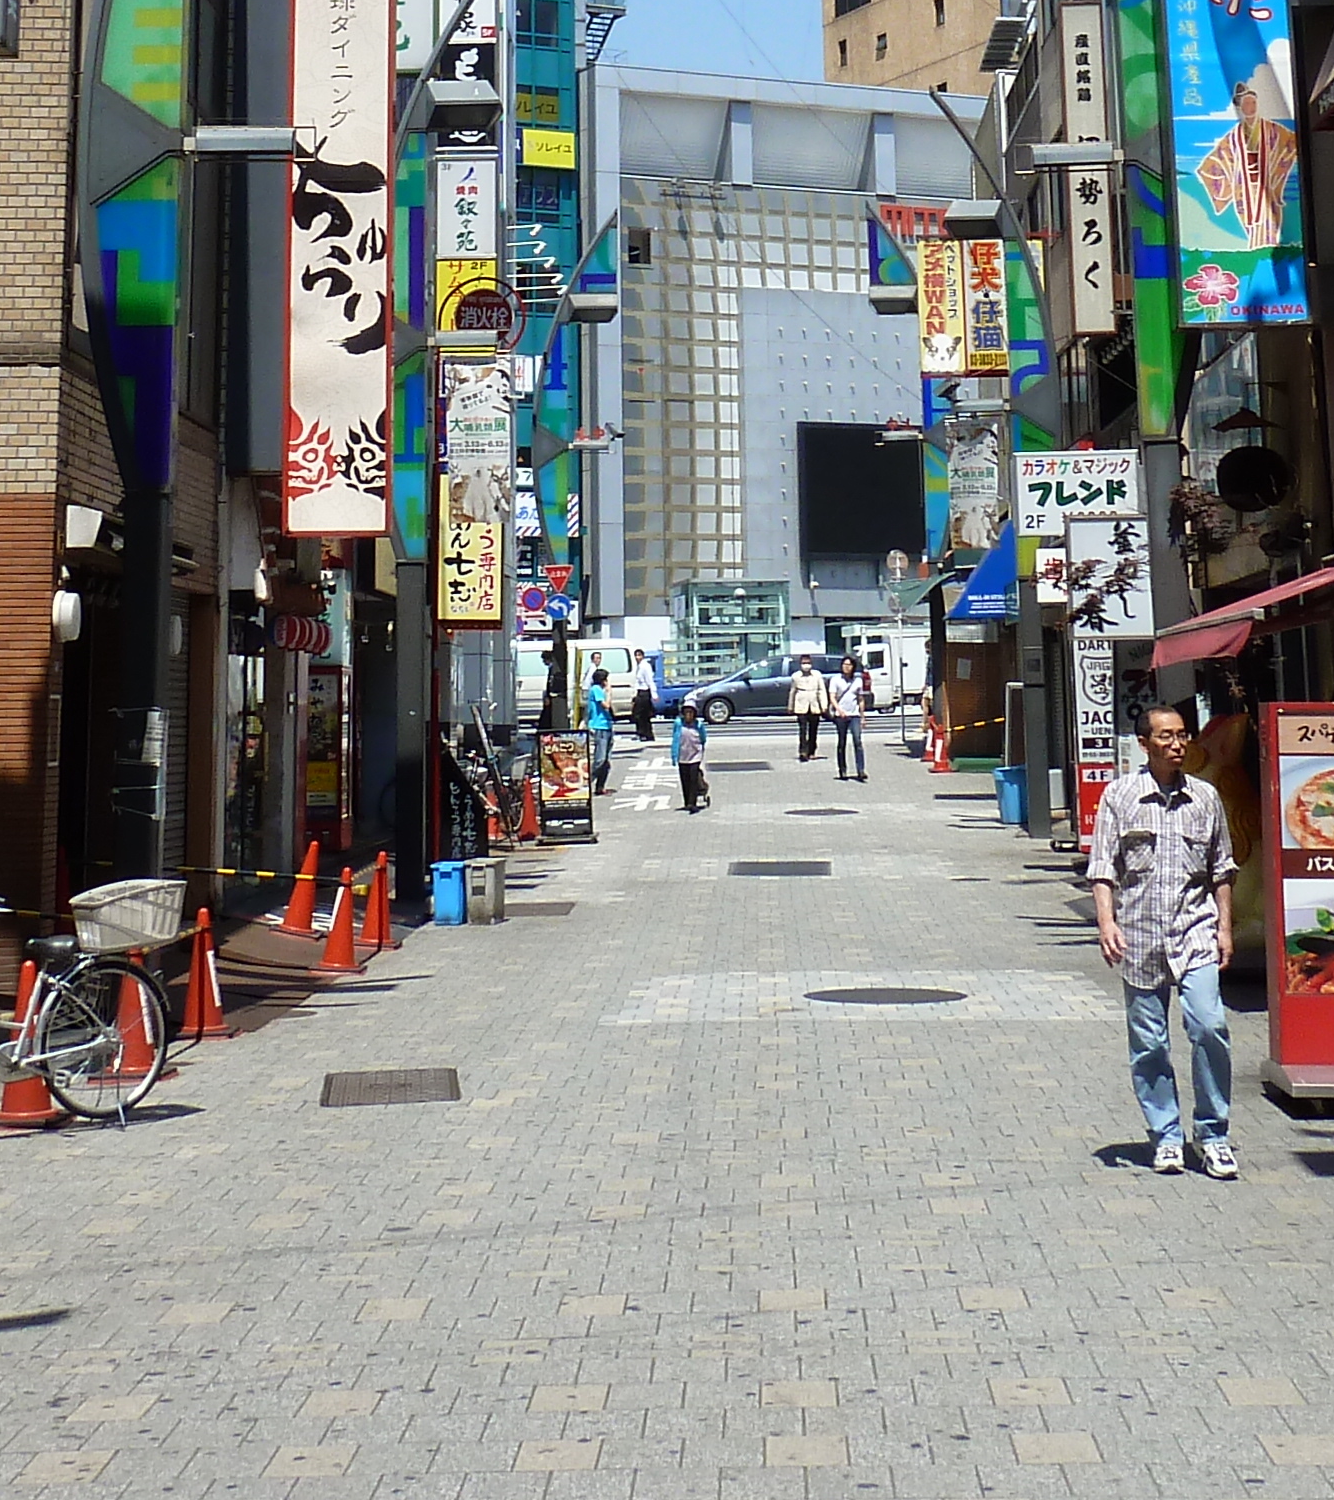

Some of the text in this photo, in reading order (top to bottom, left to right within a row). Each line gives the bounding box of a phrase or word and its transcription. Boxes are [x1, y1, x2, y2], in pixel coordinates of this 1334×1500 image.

[1077, 136, 1104, 289] 勢ろく
[470, 262, 488, 270] 2F
[460, 307, 509, 329] 消火栓
[1230, 303, 1304, 317] OKINAWA
[1022, 458, 1130, 475] カラオケ&マジック
[1028, 479, 1127, 507] フレンド
[1025, 514, 1046, 529] 2F
[1087, 770, 1109, 781] 4F
